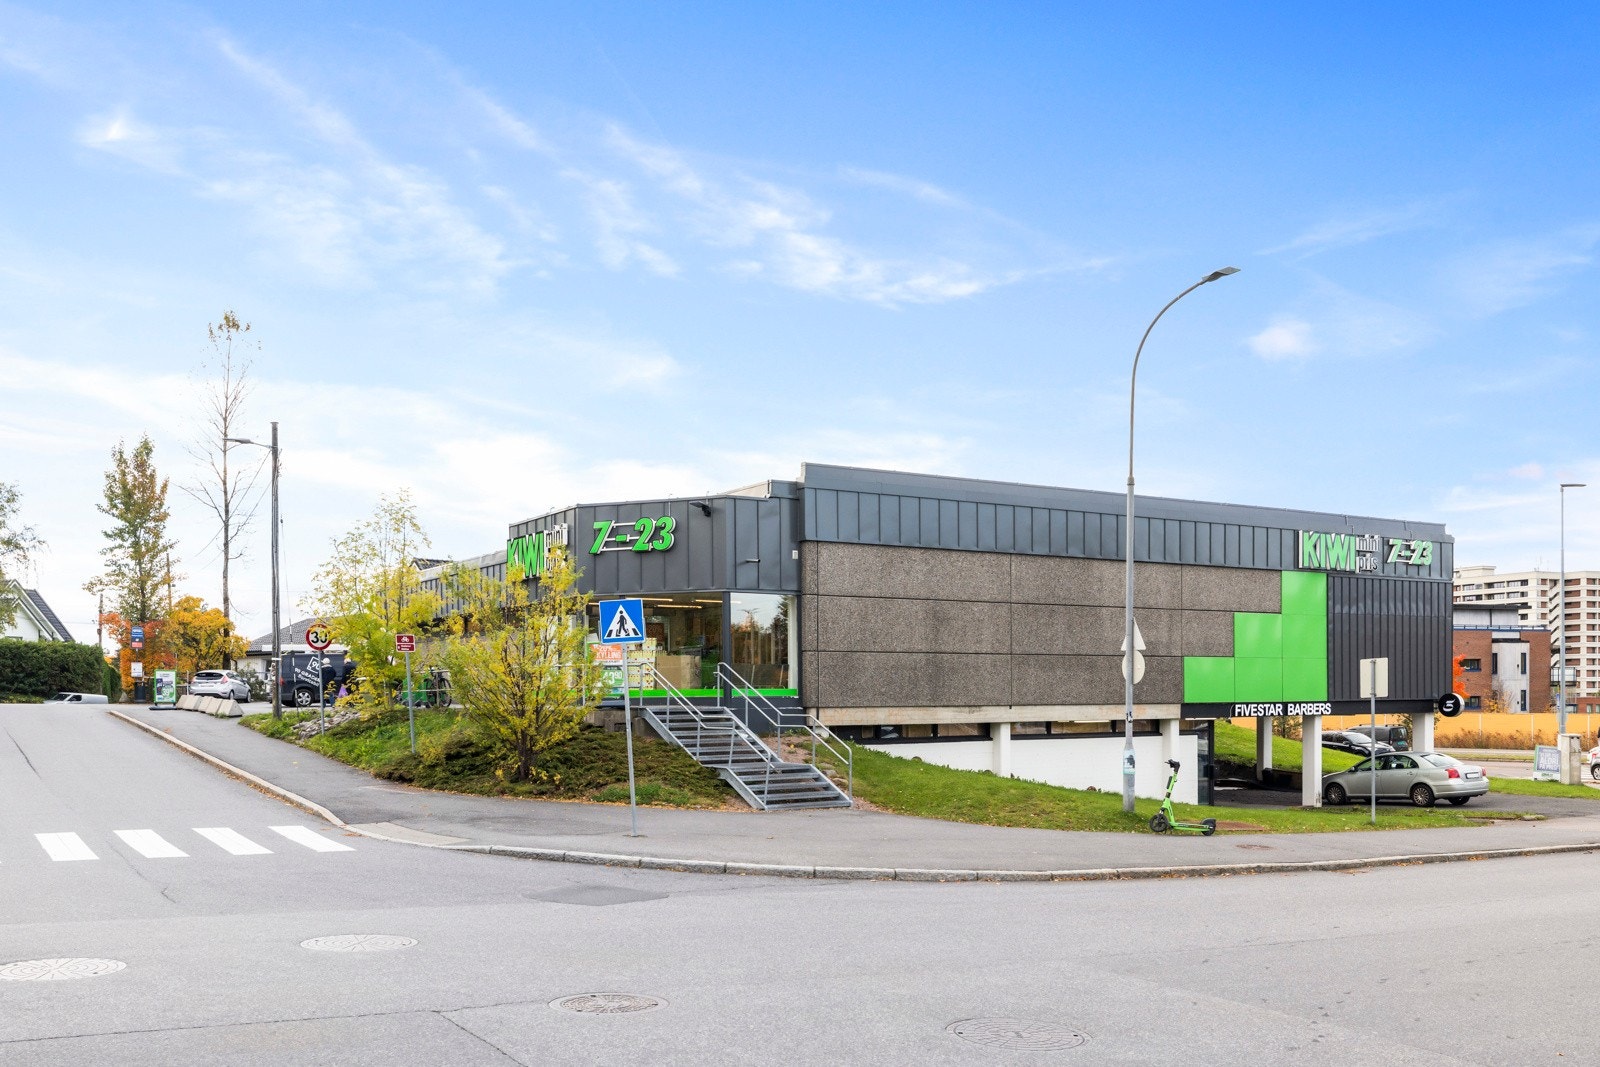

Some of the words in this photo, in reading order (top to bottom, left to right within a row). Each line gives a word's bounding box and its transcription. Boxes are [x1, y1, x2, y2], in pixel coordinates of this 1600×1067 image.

[589, 515, 676, 555] 7-23
[1356, 534, 1379, 552] mini
[507, 530, 545, 578] KIWI
[1299, 530, 1356, 573] KIWI
[1356, 553, 1378, 573] pris
[1387, 538, 1433, 566] 7-23
[310, 631, 328, 643] 30
[1234, 704, 1283, 717] FIVESTAR
[1287, 703, 1332, 716] BARBERS
